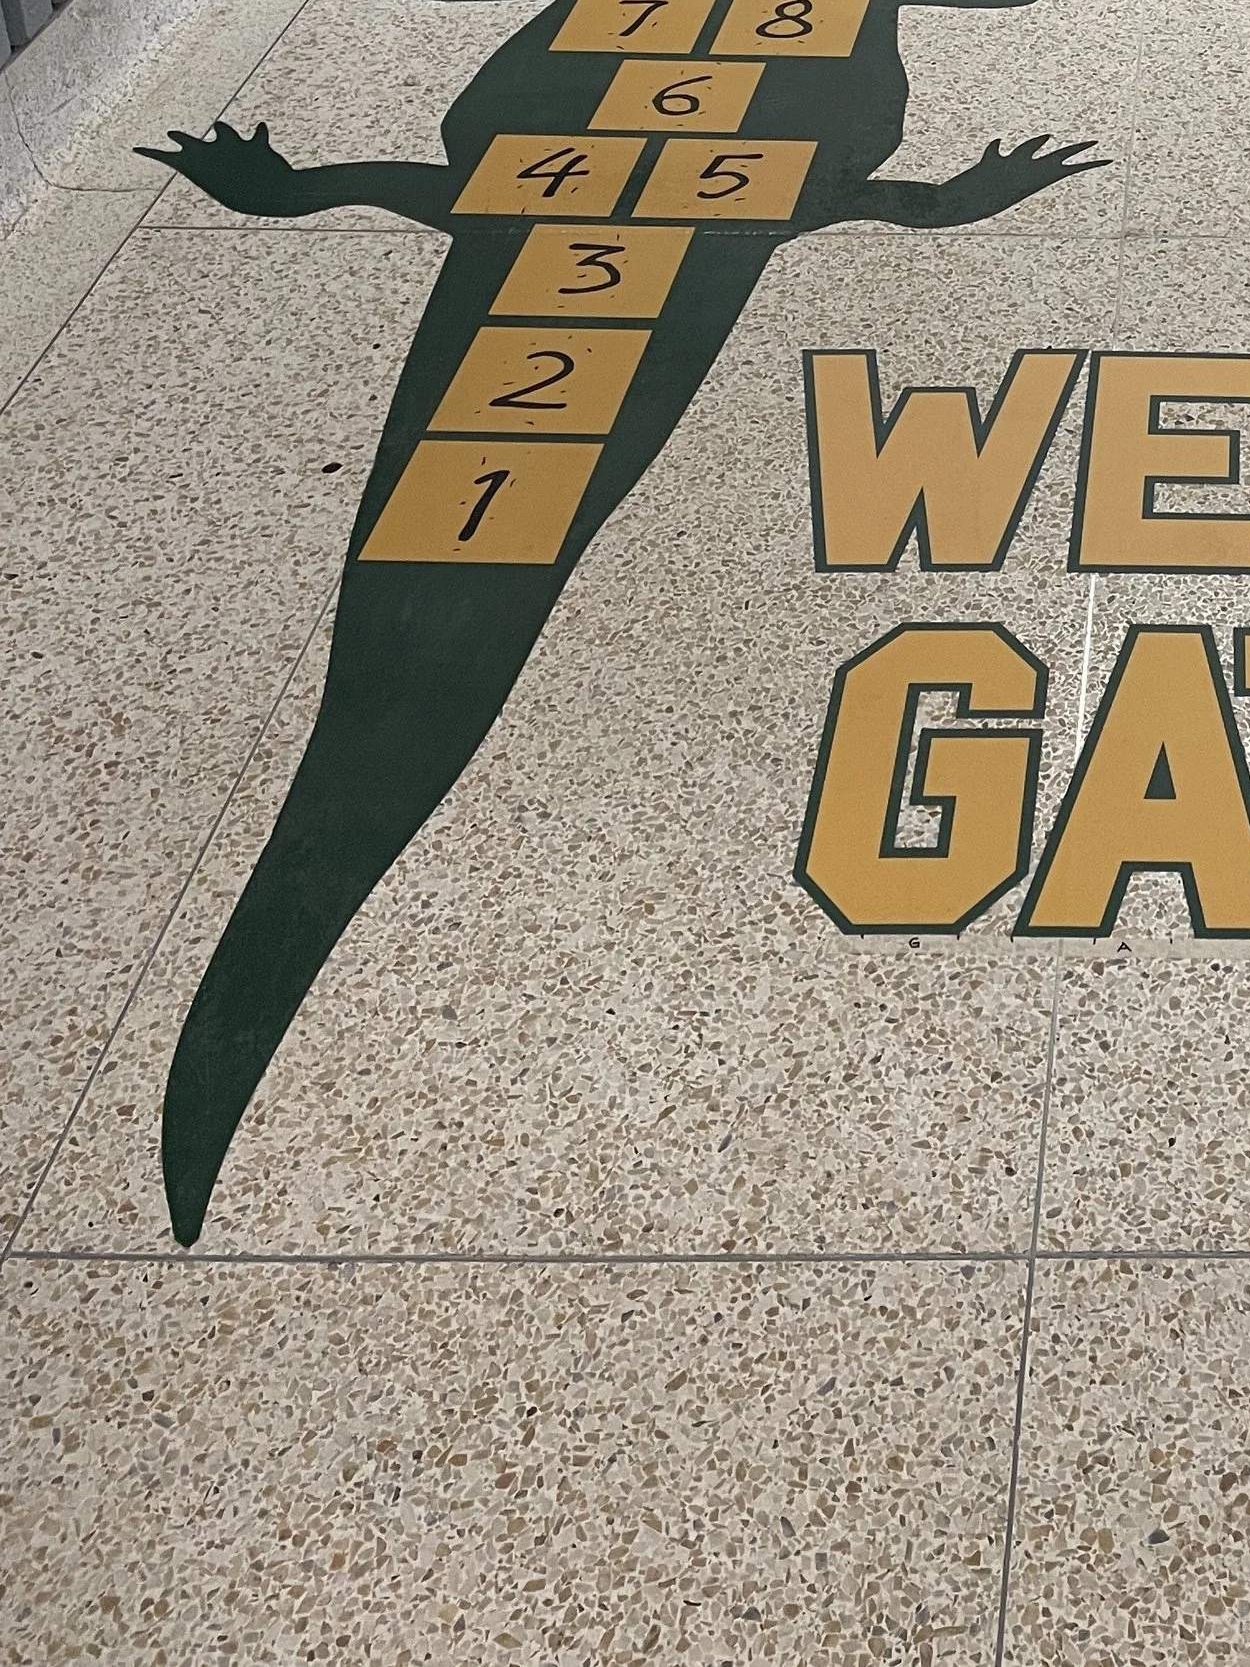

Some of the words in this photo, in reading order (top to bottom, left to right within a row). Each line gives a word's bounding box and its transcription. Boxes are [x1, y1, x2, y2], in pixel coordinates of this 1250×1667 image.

[618, 0, 669, 37] 7
[651, 75, 713, 116] 6
[516, 147, 591, 198] 4
[696, 153, 764, 200] 5
[557, 243, 626, 295] 3
[488, 350, 575, 410] 2
[457, 469, 511, 542] 1
